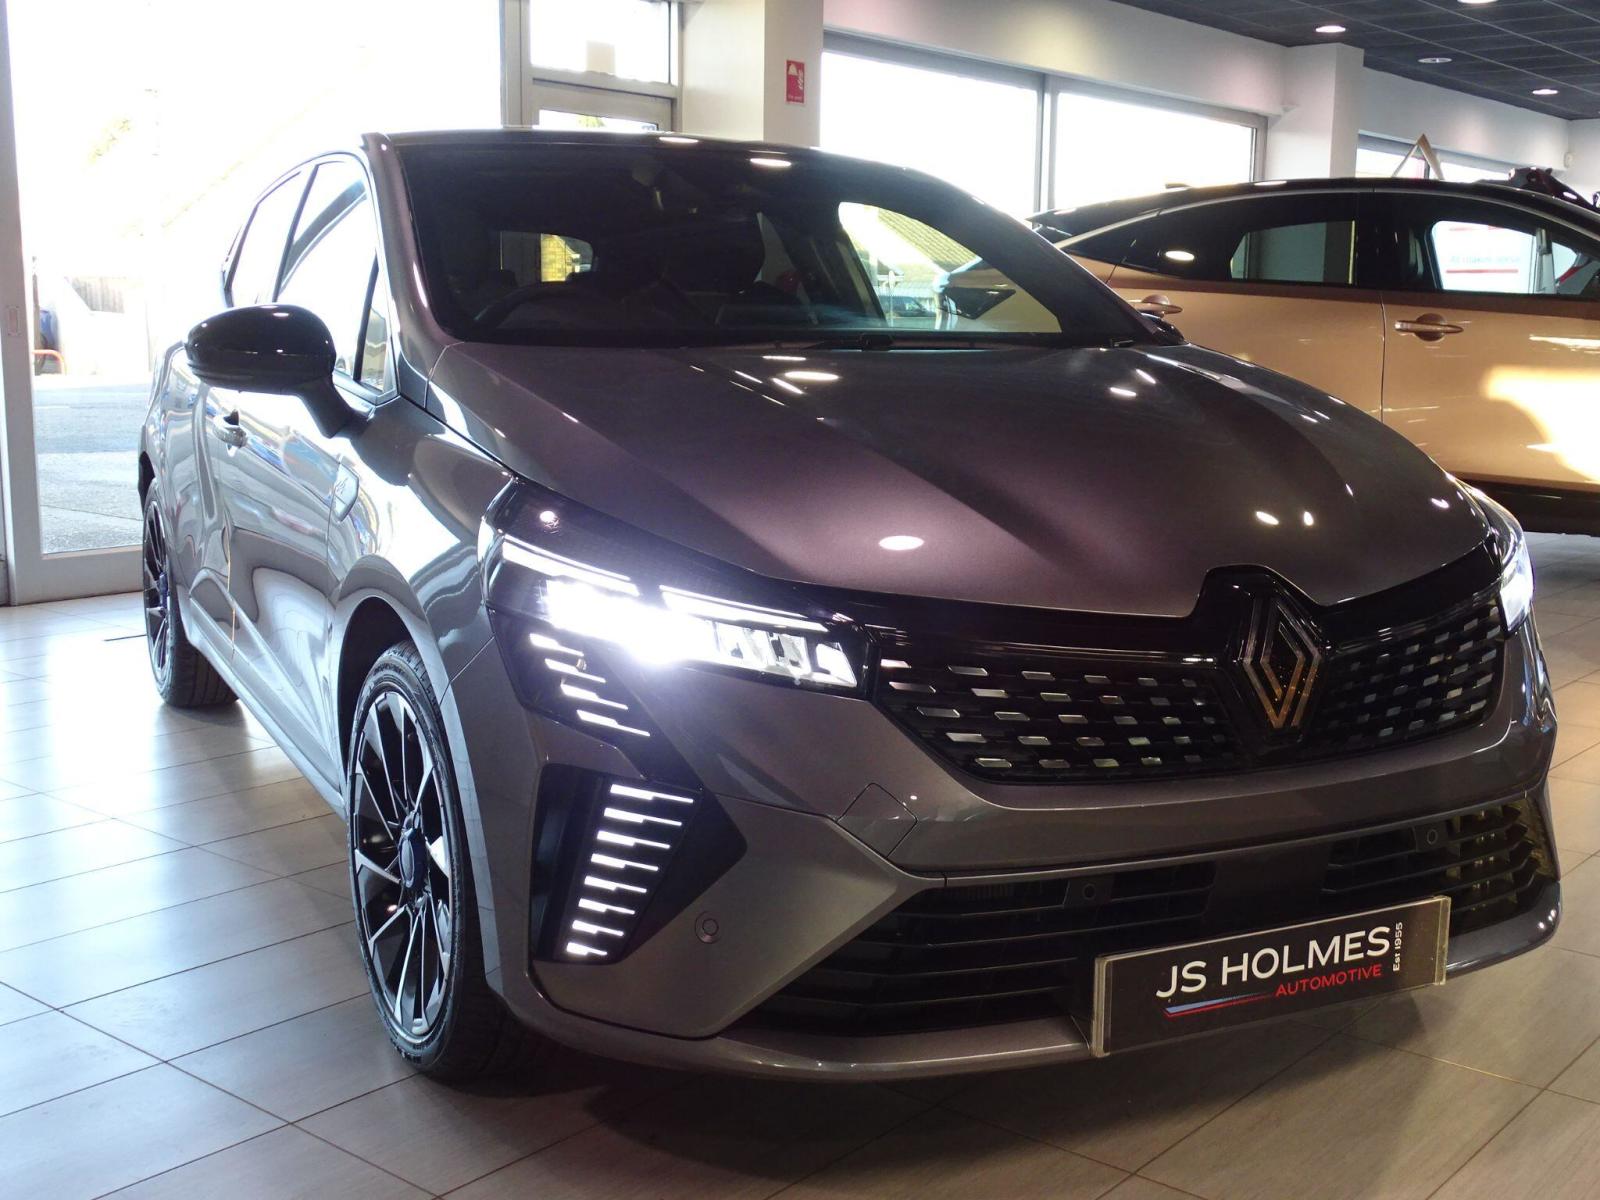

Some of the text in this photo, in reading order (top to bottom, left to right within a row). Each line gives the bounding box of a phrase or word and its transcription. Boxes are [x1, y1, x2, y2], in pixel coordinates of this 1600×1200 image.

[1156, 926, 1391, 998] JS HOLMES
[1392, 921, 1403, 972] Est 1955
[1275, 963, 1383, 997] AUTOMOTIVE
